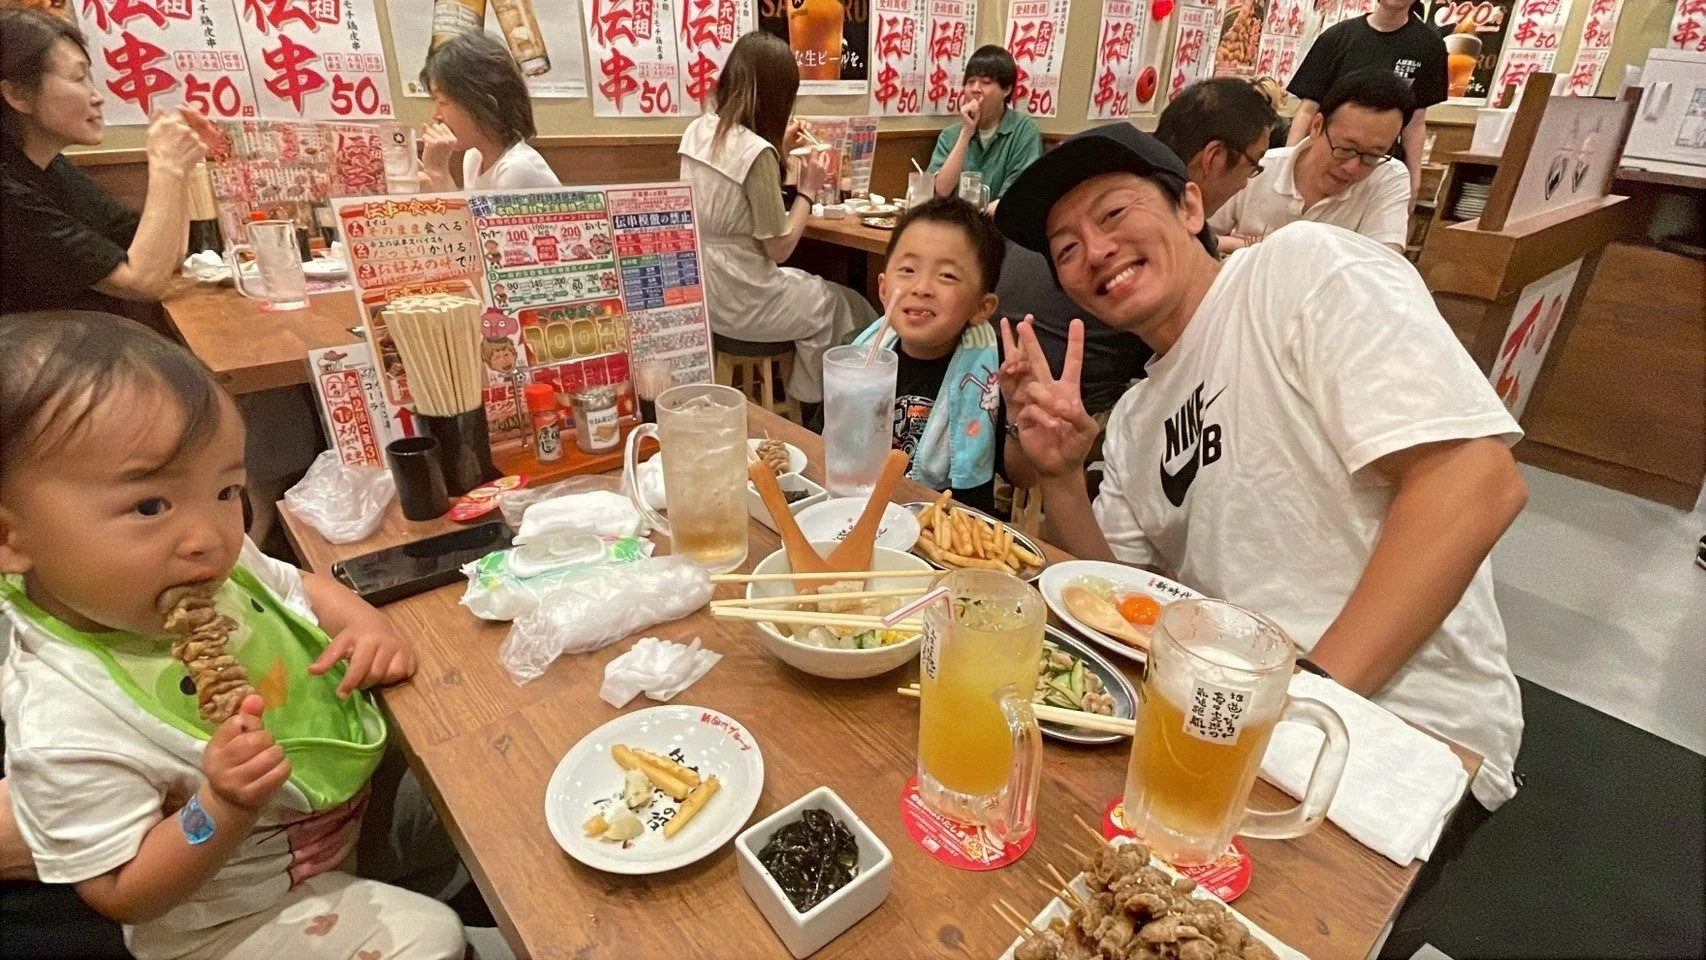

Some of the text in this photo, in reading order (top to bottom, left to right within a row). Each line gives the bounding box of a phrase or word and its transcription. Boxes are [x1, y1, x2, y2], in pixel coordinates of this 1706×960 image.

[874, 13, 902, 113] 伝串
[928, 18, 952, 112] 伝串
[507, 230, 528, 242] 100
[562, 226, 581, 238] 200
[1163, 380, 1206, 464] NIKE
